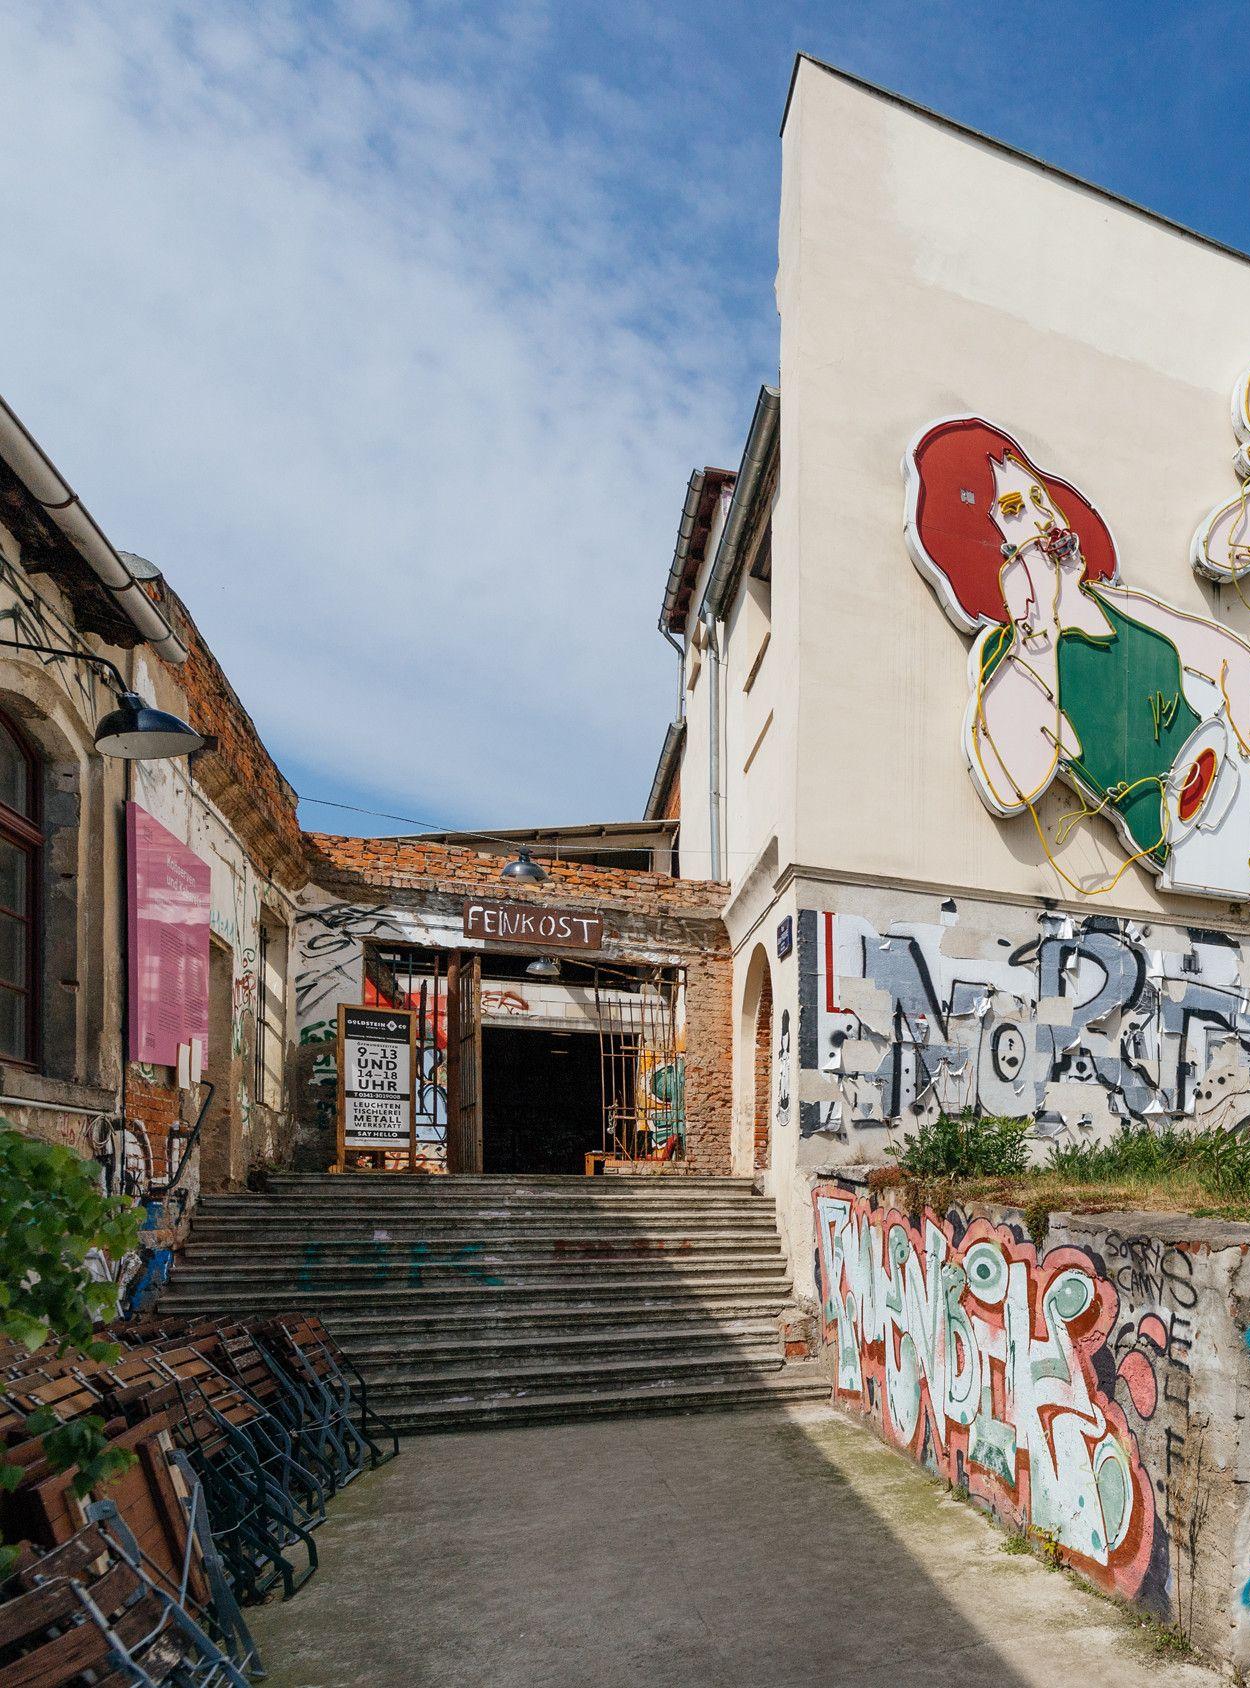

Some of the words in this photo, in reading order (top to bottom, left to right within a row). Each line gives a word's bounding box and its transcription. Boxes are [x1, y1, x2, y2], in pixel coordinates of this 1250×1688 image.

[467, 905, 599, 944] FEINKOST
[347, 1019, 386, 1028] GOLDSTEIN
[357, 1058, 398, 1071] UND
[358, 1079, 398, 1092] UHR
[353, 1102, 401, 1110] LEUCHTEN
[353, 1108, 401, 1116] TISCHLEREI
[353, 1115, 402, 1124] METALL
